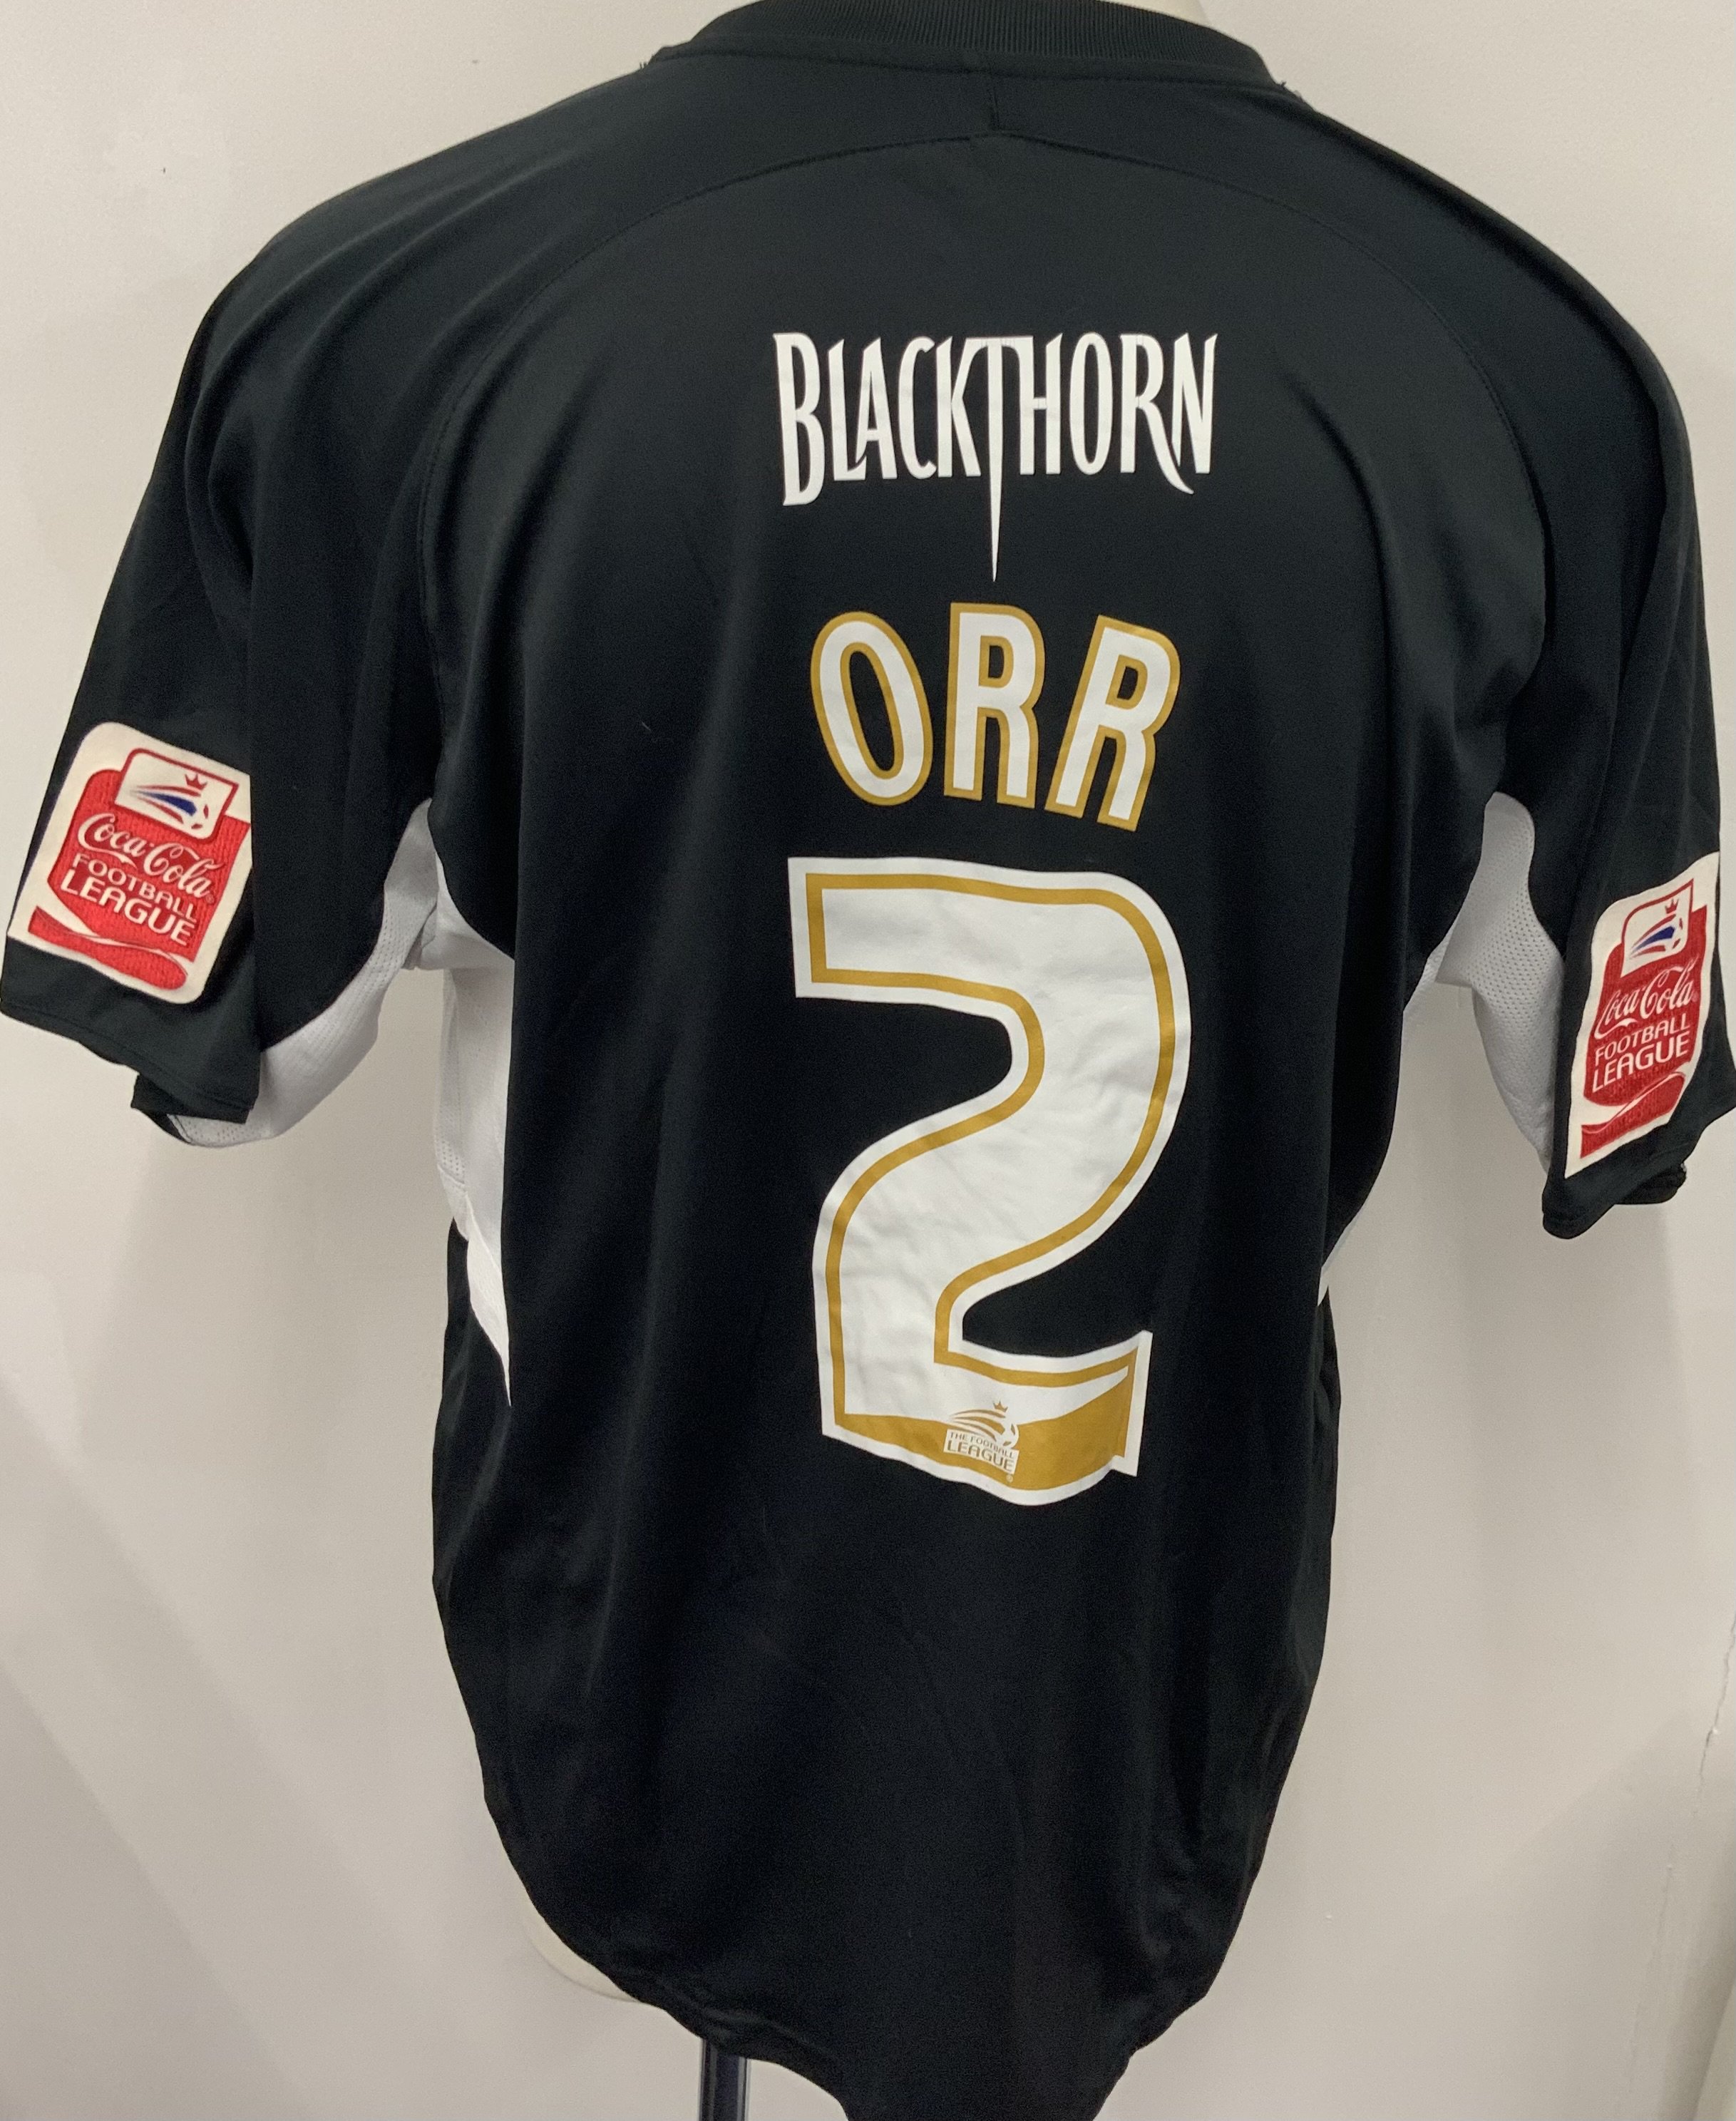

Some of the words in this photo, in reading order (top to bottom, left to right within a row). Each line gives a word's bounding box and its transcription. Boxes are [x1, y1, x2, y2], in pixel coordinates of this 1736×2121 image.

[773, 332, 1218, 582] BLACKTHORN
[811, 602, 1181, 831] ORR
[61, 869, 195, 946] LEAGUE
[72, 853, 197, 923] FOOTBALL
[1593, 1039, 1690, 1093] LEAGUE
[1595, 1013, 1690, 1066] FOOTBALL
[788, 856, 1191, 1506] 2
[947, 1440, 1015, 1472] LEAGUE
[950, 1432, 967, 1440] THE
[970, 1436, 1014, 1458] FOOTBALL
